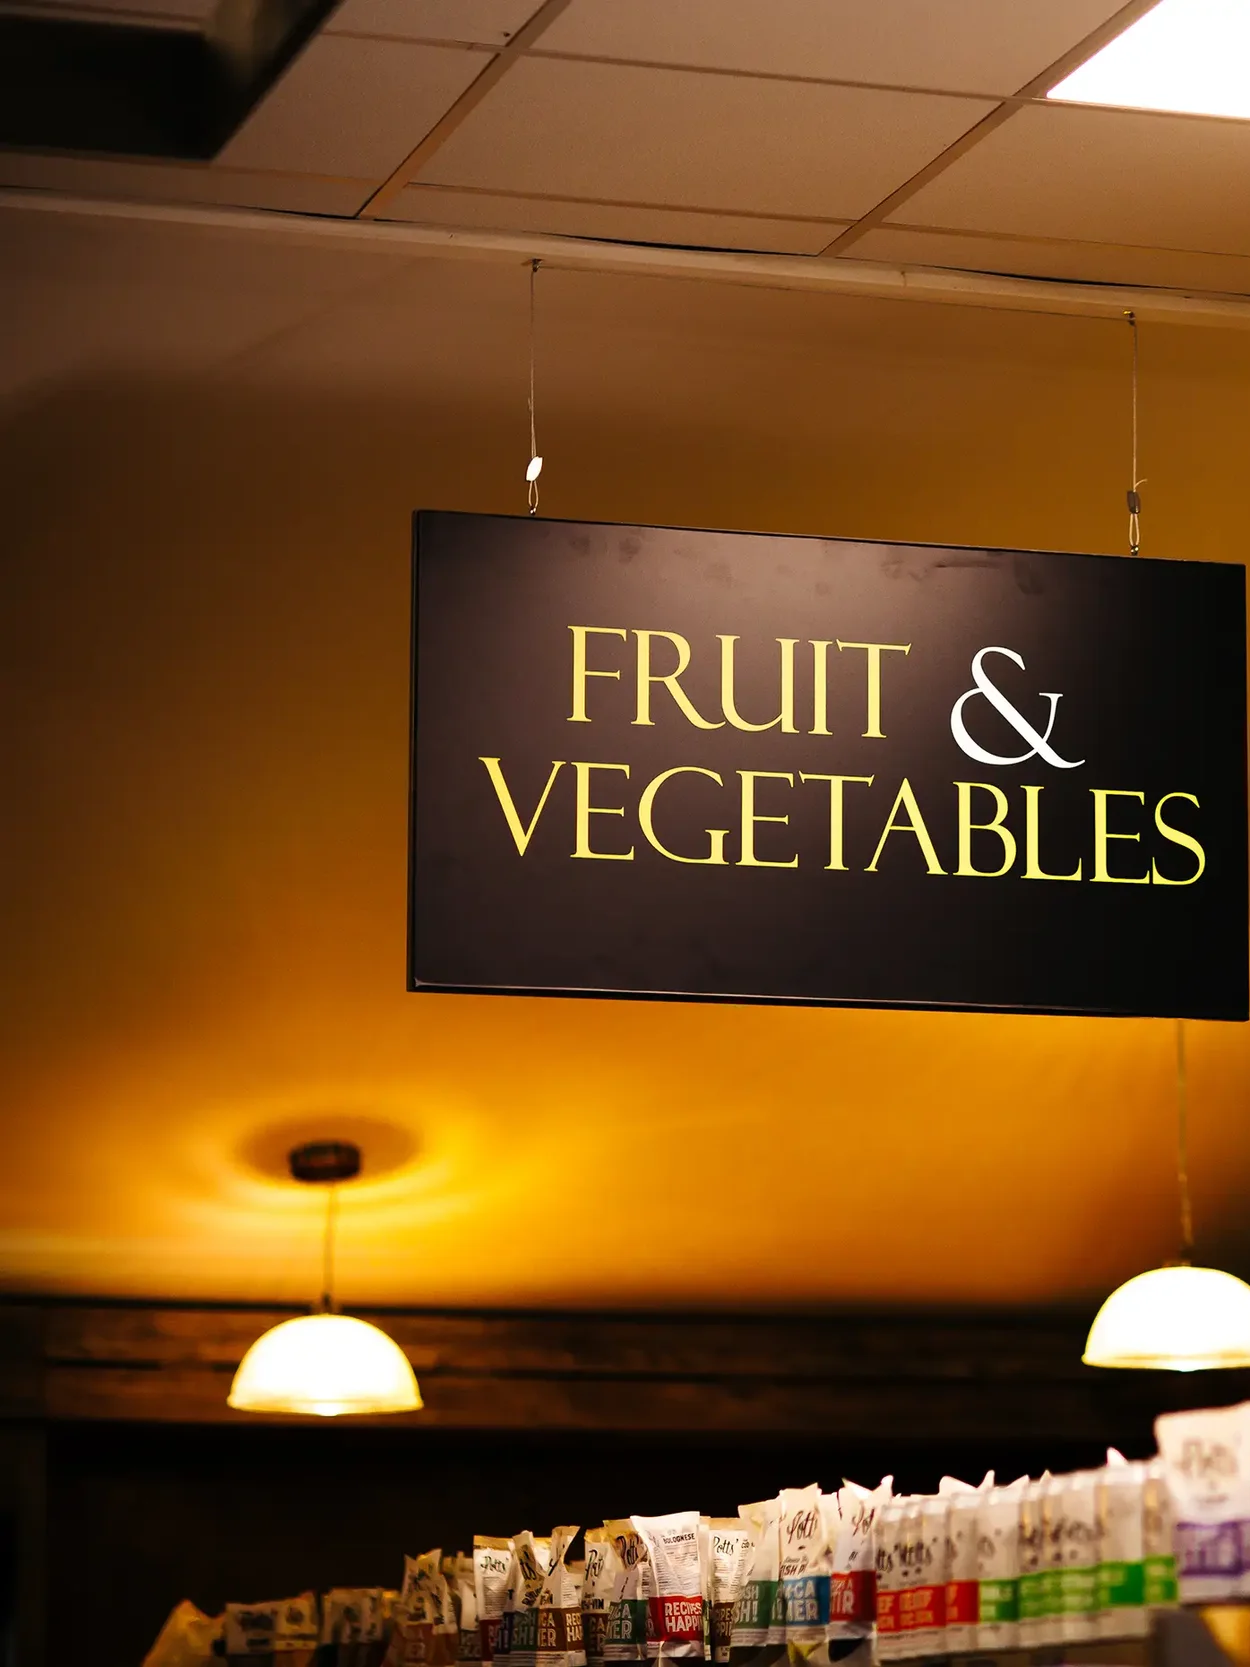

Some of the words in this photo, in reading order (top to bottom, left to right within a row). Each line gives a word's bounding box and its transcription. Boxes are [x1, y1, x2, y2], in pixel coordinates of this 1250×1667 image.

[566, 625, 912, 739] FRUIT
[950, 645, 1086, 769] &
[478, 756, 1207, 886] VEGETABLES
